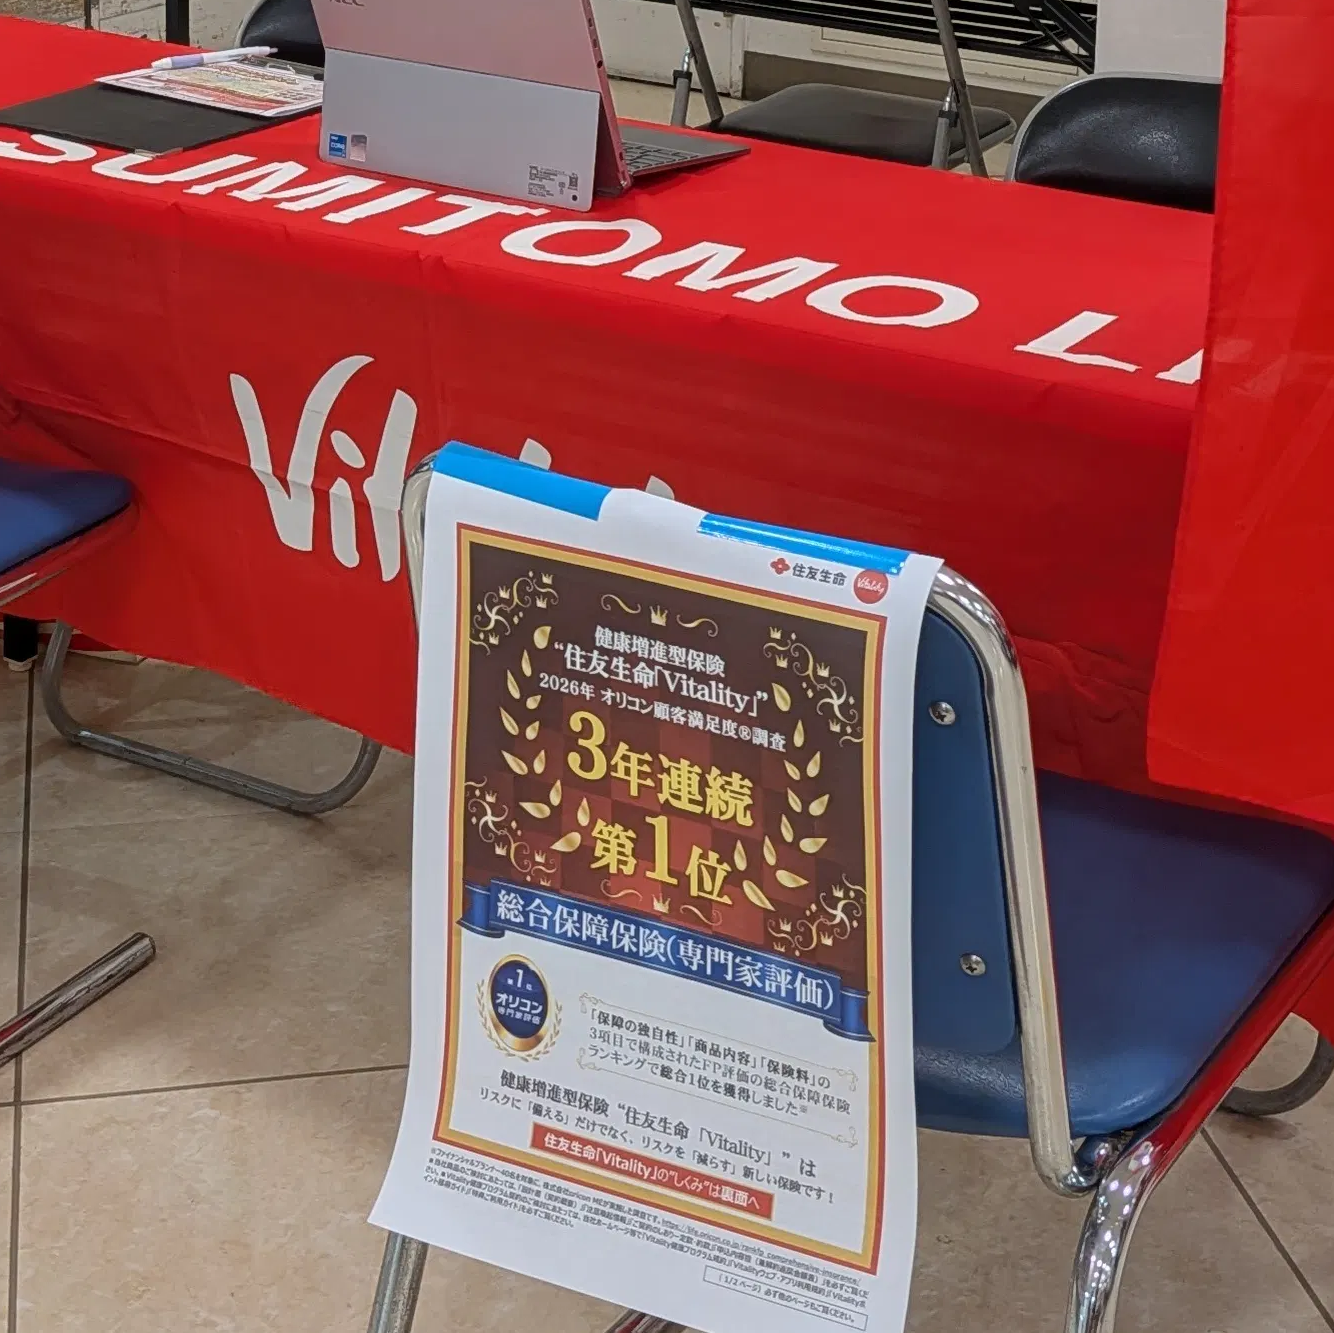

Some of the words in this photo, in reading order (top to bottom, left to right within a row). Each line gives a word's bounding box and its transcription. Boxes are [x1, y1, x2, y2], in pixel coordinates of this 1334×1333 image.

[792, 562, 847, 587] 住友生命
[857, 575, 885, 596] Vitality
[595, 625, 725, 678] 健康増進型保険
[567, 710, 754, 827] 3年連続
[589, 815, 733, 905] 第1位
[496, 992, 543, 1015] オリコン
[497, 1006, 541, 1025] 専門家評価
